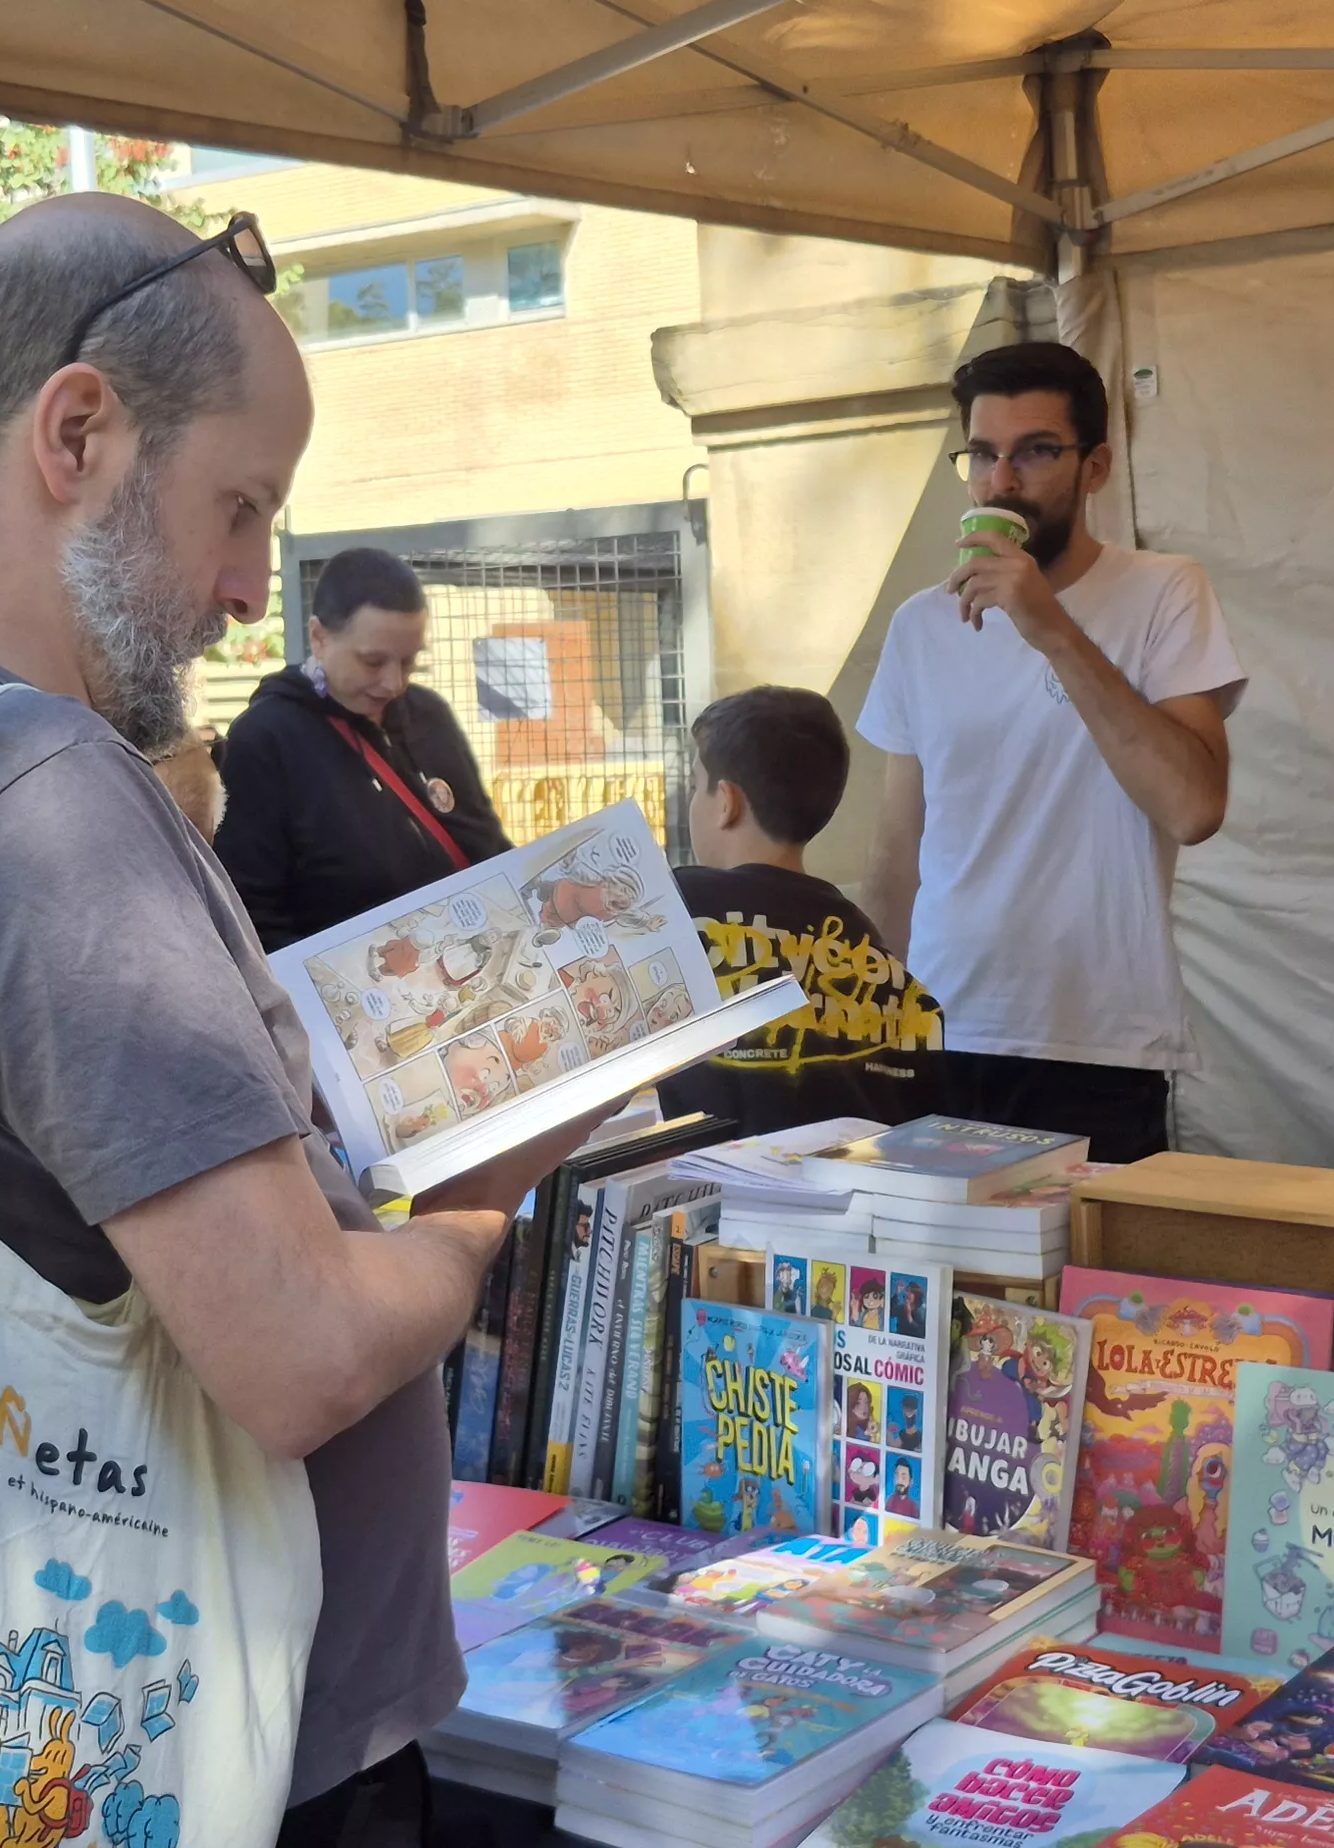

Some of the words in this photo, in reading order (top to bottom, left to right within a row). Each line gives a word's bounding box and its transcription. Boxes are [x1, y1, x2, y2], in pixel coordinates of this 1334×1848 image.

[927, 1121, 1056, 1146] INTRUSOS
[631, 1242, 649, 1313] MIENTRAS
[567, 1274, 581, 1341] GUERRAS
[868, 1335, 878, 1346] DE
[879, 1337, 887, 1347] LA
[888, 1338, 926, 1353] NARRATIVA
[1097, 1338, 1155, 1375] LOLA
[560, 1345, 573, 1379] LUCAS
[625, 1340, 640, 1399] VERANO
[873, 1356, 925, 1386] CÓMIC
[558, 1379, 569, 1392] 2
[705, 1359, 799, 1434] CHISTE
[717, 1412, 796, 1486] PEDIA
[7, 1474, 26, 1490] et
[30, 1482, 170, 1538] hispano-américaine
[640, 1529, 710, 1550] CLUB
[766, 1644, 864, 1672] CATY
[737, 1656, 887, 1696] CUIDADORA
[751, 1672, 815, 1689] GATOS
[1026, 1652, 1242, 1708] PizzaGoblin
[925, 1814, 940, 1825] y
[943, 1817, 1035, 1840] enfrentar
[930, 1823, 1024, 1848] fantasmas
